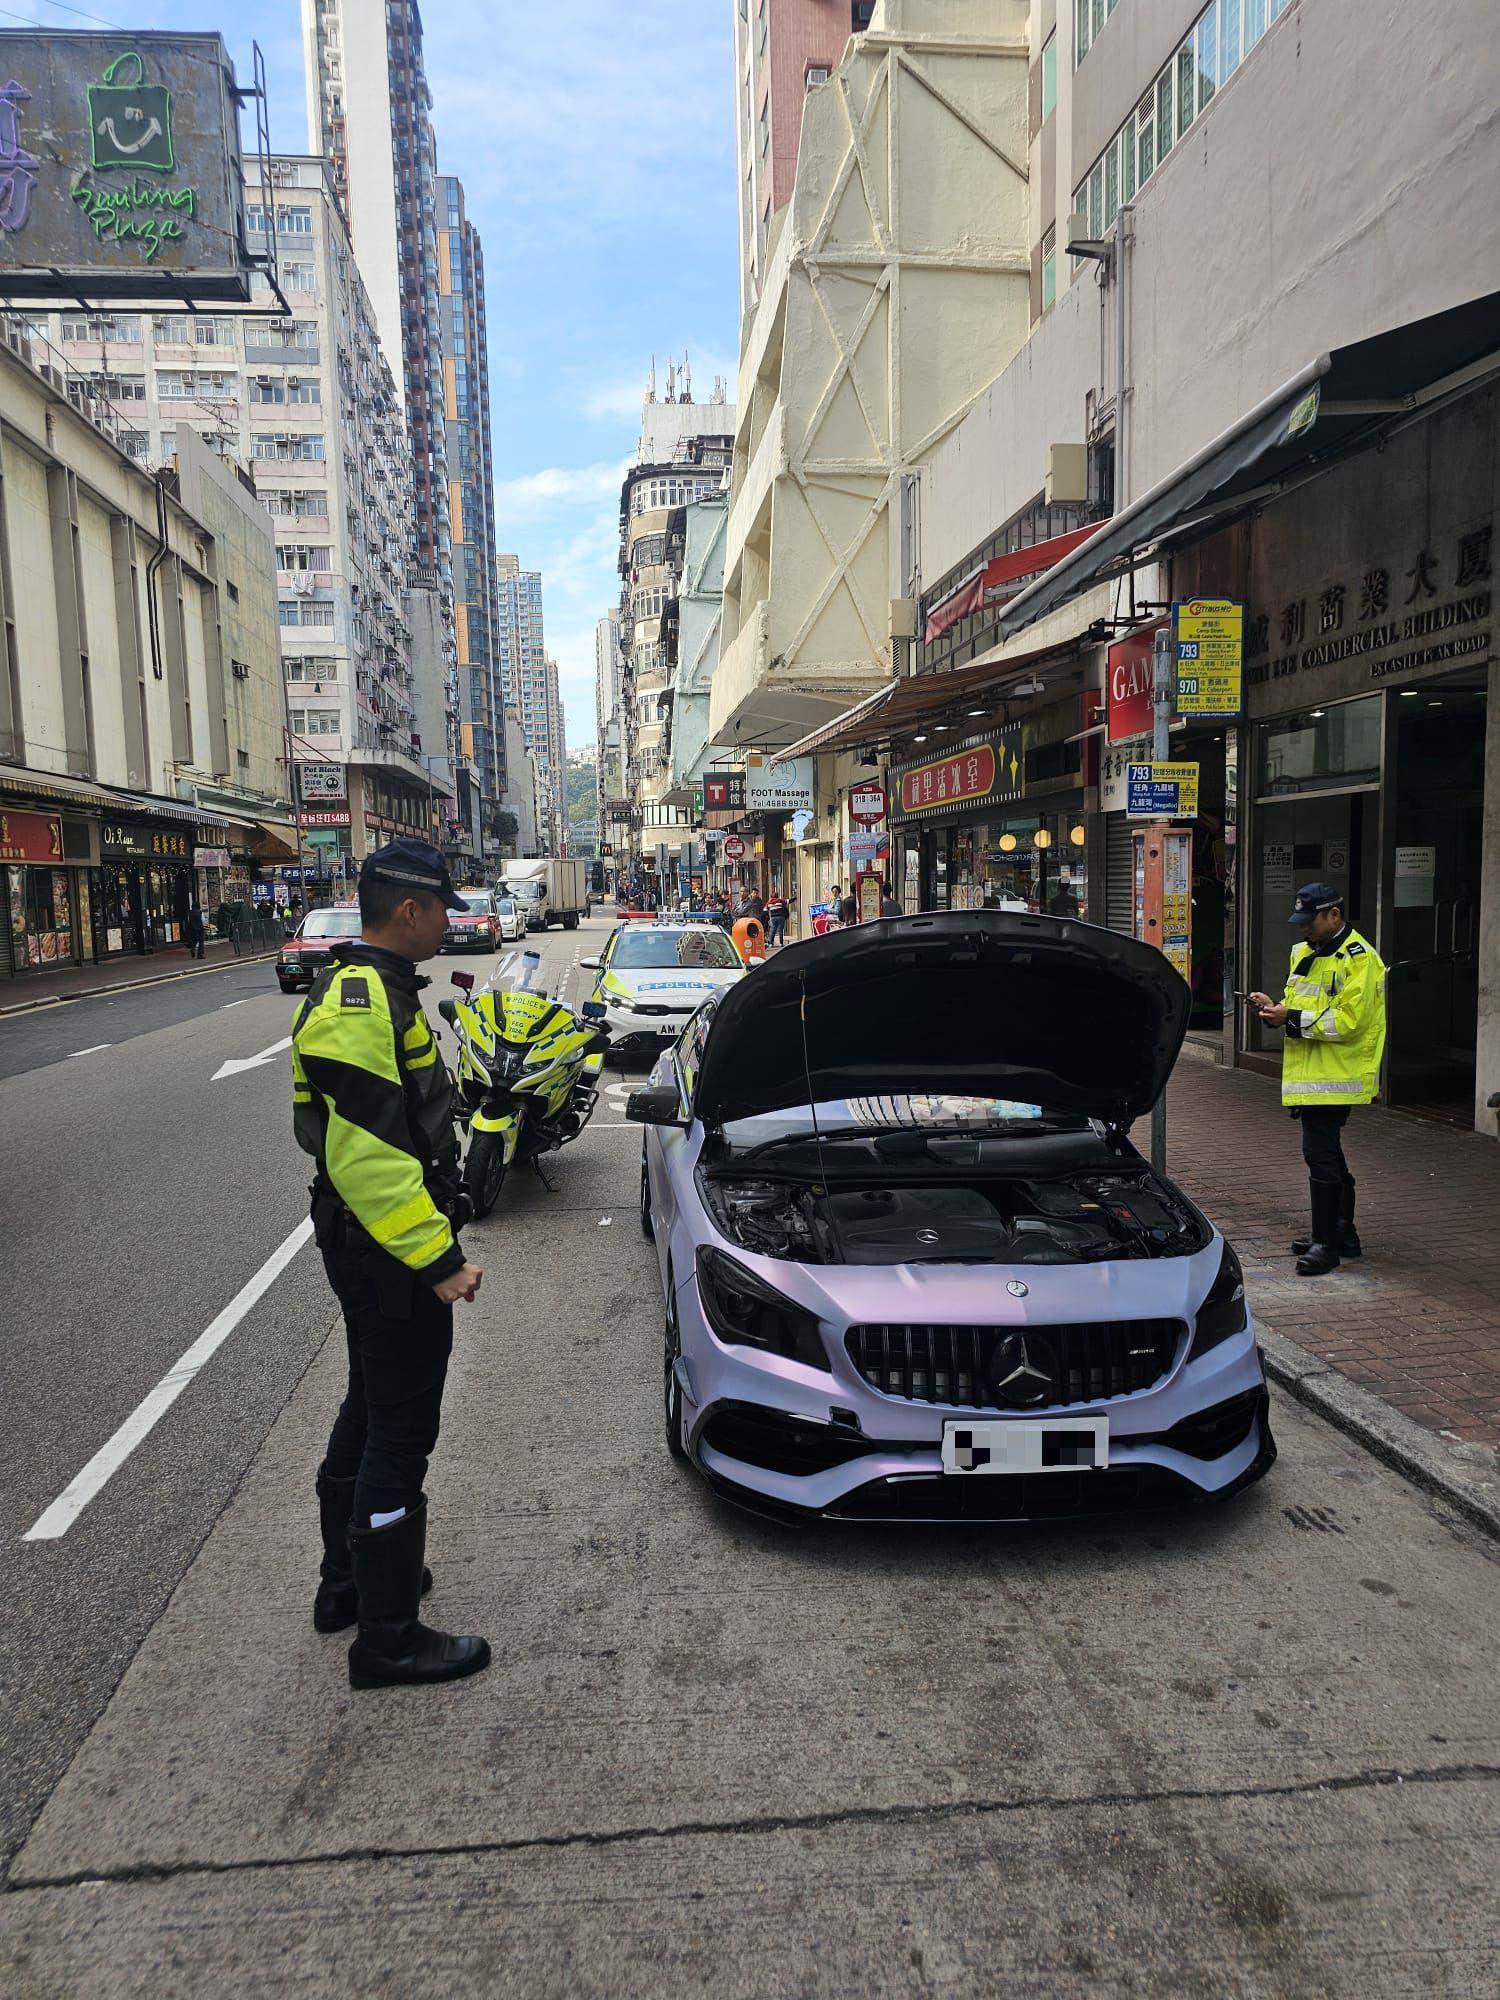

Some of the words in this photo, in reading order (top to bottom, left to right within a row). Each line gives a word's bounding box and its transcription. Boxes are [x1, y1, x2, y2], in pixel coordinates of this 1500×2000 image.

[1299, 624, 1395, 670] COMMERCIAL
[1402, 596, 1487, 640] BUILDING
[1180, 644, 1198, 658] 793
[1454, 635, 1486, 655] ROAD
[1179, 679, 1197, 693] 970
[1132, 766, 1149, 780] 793
[911, 756, 978, 805] 荷里活冰室
[709, 785, 724, 800] T
[751, 789, 774, 797] FOOT
[775, 789, 810, 799] Massage
[512, 996, 539, 1009] POLICE
[660, 1025, 676, 1034] AM
